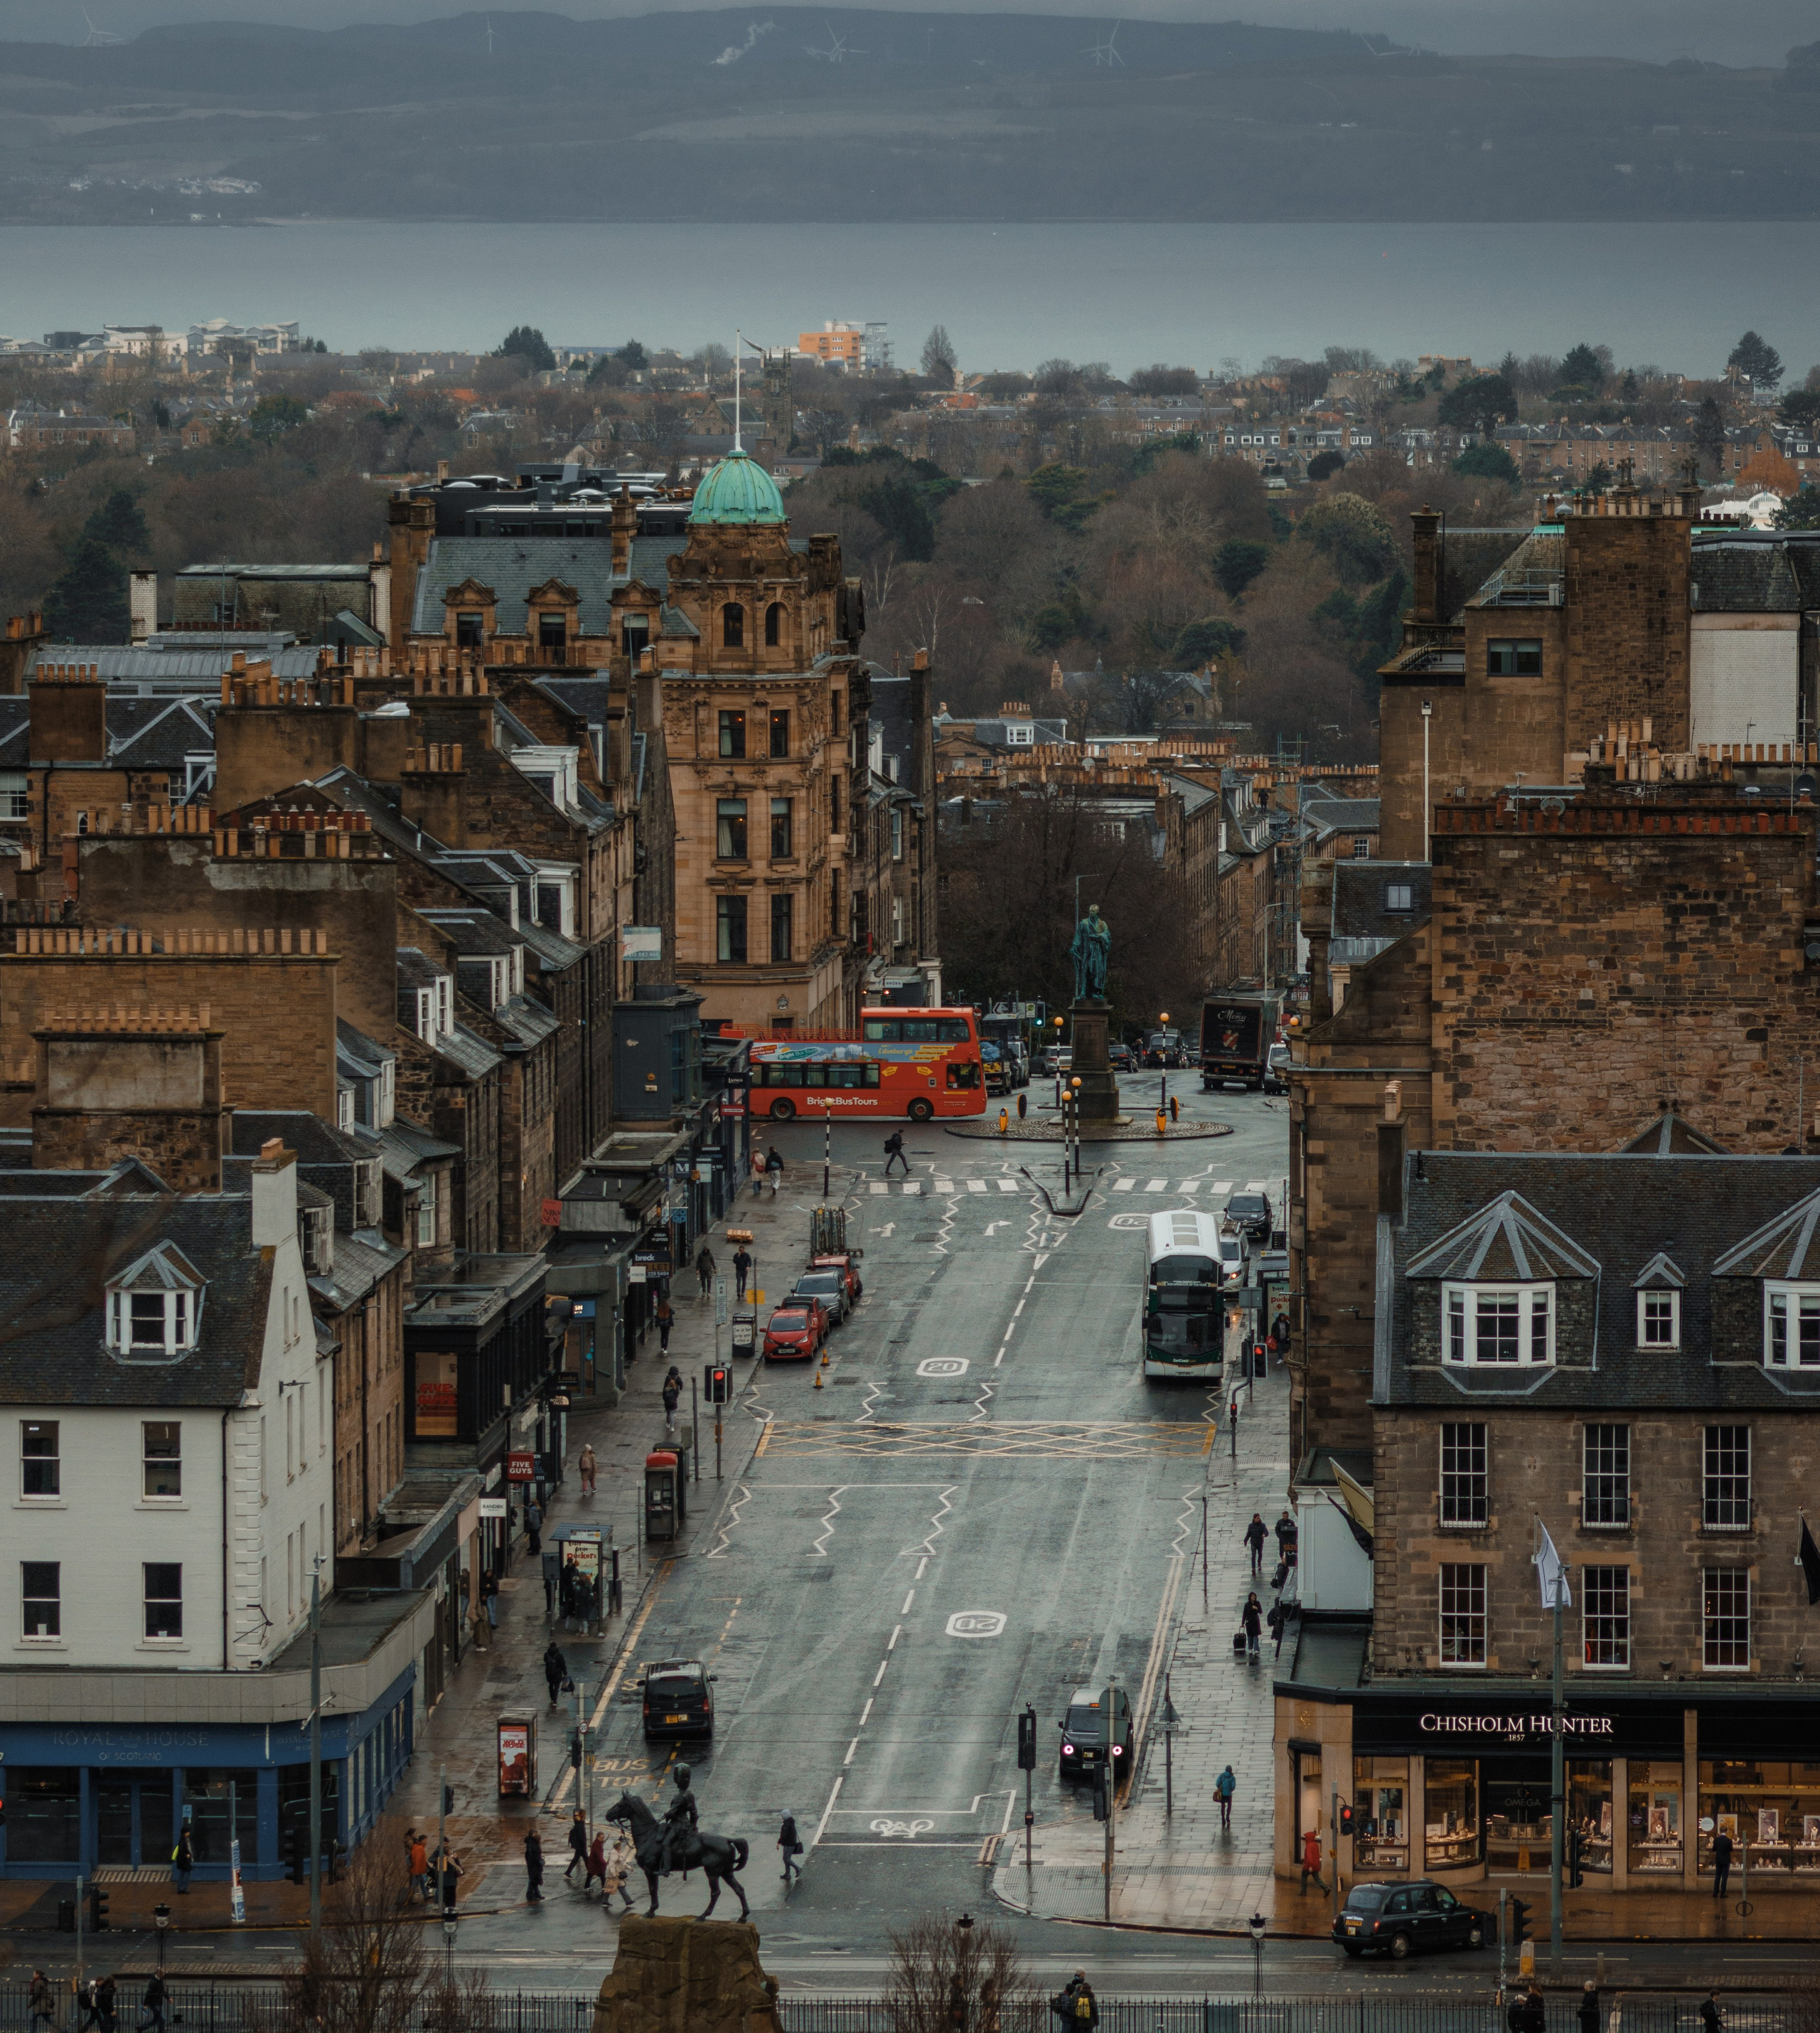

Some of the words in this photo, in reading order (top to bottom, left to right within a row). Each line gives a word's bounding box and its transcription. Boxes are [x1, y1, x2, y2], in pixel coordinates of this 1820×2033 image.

[1218, 1010, 1247, 1023] Menu
[676, 1163, 690, 1172] M
[927, 1361, 958, 1372] 20
[420, 1383, 454, 1393] FIVE
[958, 1617, 995, 1631] 20
[1420, 1714, 1524, 1732] CHISHOLM
[1529, 1716, 1614, 1733] HUNTER
[53, 1731, 116, 1746] ROYAL
[146, 1731, 209, 1746] HOUSE
[100, 1752, 111, 1761] OF
[114, 1752, 161, 1761] SCOTLAND
[592, 1759, 651, 1772] BUS
[1504, 1798, 1541, 1806] OMEGA
